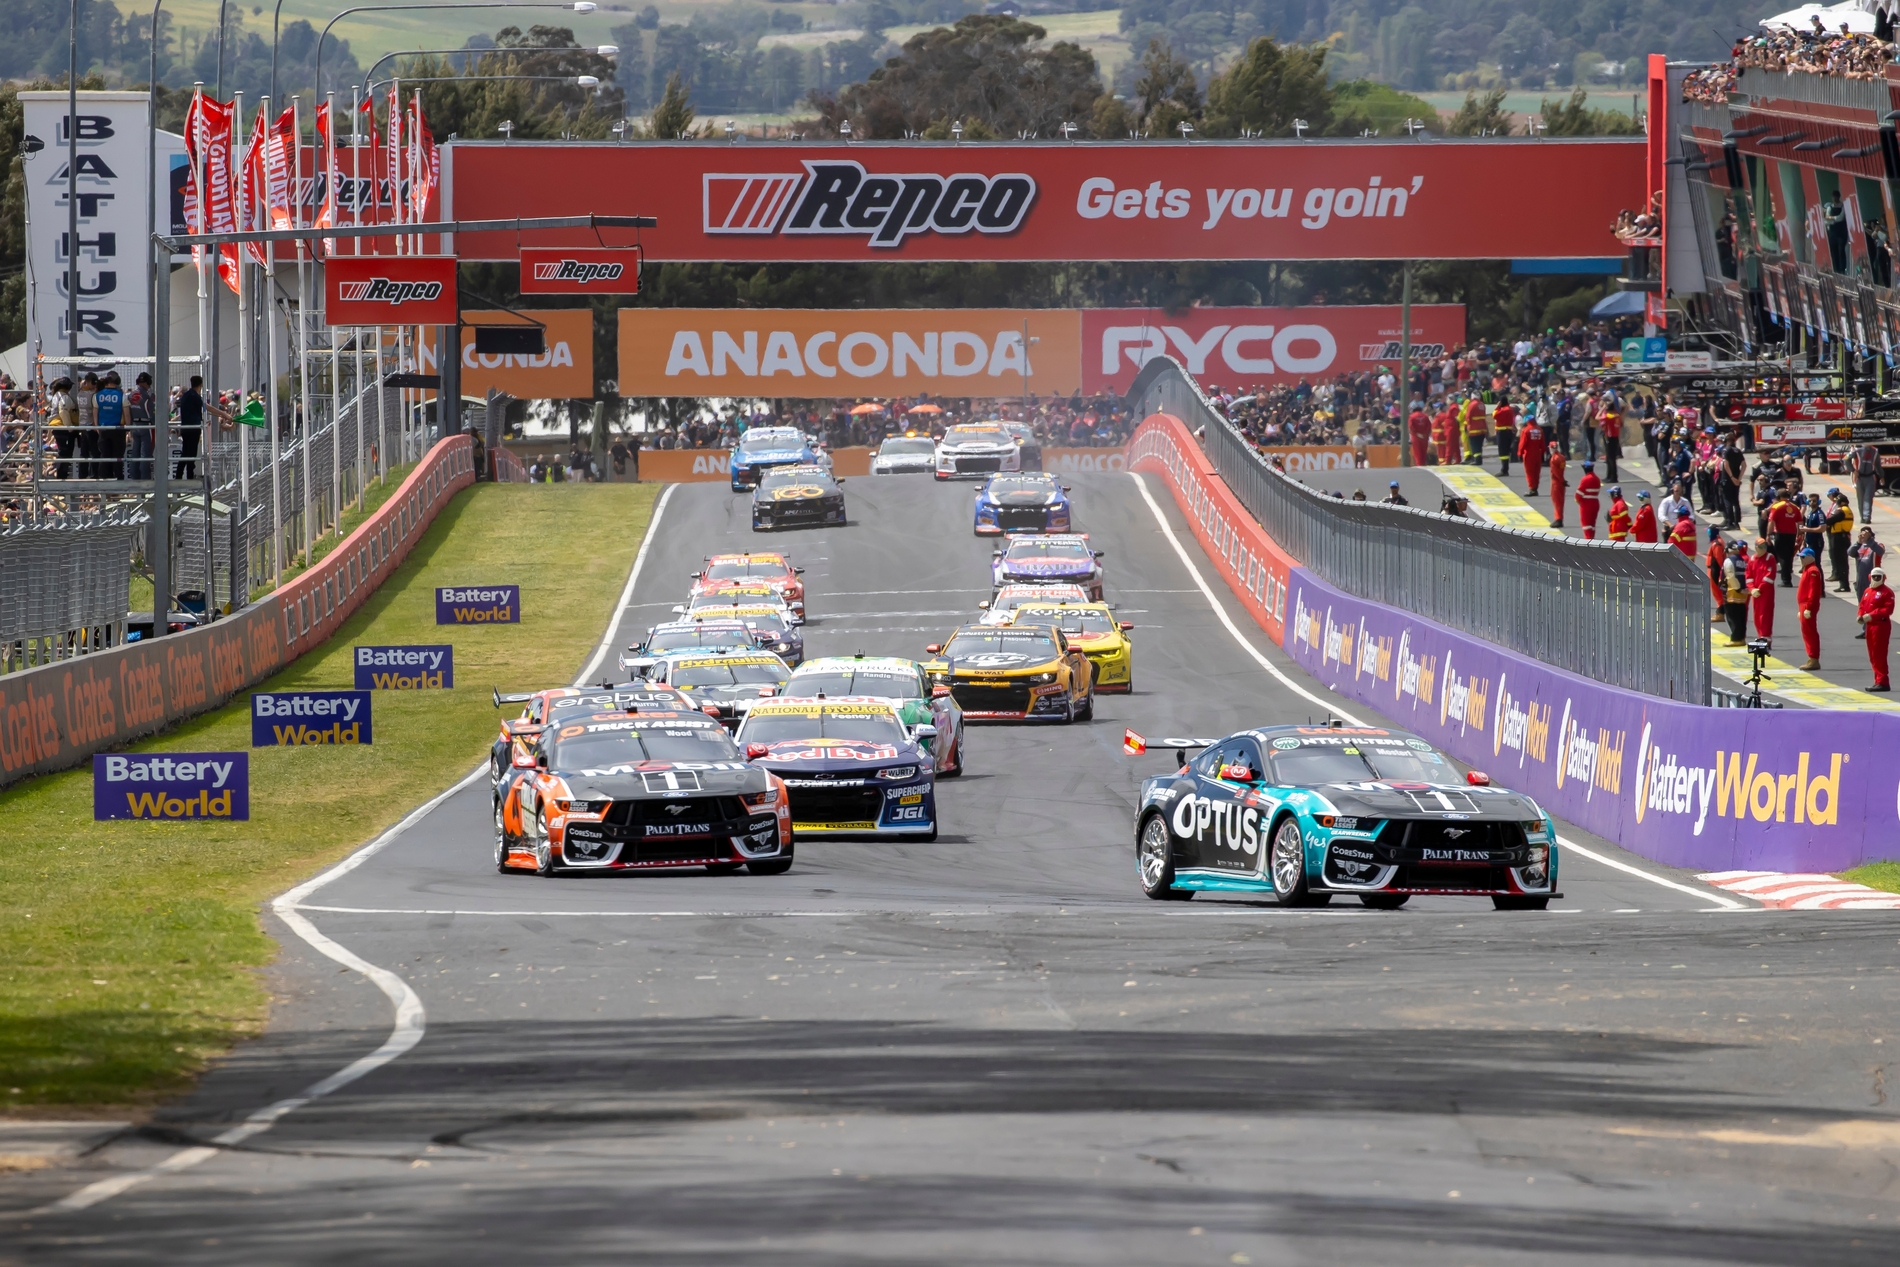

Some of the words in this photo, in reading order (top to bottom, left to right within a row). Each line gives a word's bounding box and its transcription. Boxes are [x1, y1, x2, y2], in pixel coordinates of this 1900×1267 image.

[783, 161, 1036, 246] Repco
[1077, 177, 1191, 219] Gets
[1203, 188, 1293, 229] you
[557, 260, 623, 283] Repco
[369, 278, 442, 304] Repco
[665, 331, 1032, 377] ANACONDA
[1102, 325, 1336, 374] RYCO
[99, 394, 119, 403] 040
[1745, 408, 1766, 417] Pizza
[1767, 408, 1783, 416] Hut
[442, 588, 511, 605] Battery
[454, 606, 511, 622] World
[1026, 608, 1101, 616] Kubota
[358, 648, 444, 670] Battery
[679, 656, 779, 668] Hydraulink
[372, 671, 443, 689] World
[120, 653, 164, 729] Coates
[555, 692, 675, 708] erebus
[64, 666, 116, 747] Coates
[256, 695, 361, 721] Battery
[753, 706, 818, 716] NATIONAL
[824, 706, 890, 715] STORAGE
[273, 722, 360, 746] World
[587, 721, 648, 732] TRUCK
[650, 720, 714, 729] ASSIST
[1296, 727, 1391, 737] Coates
[1301, 737, 1342, 746] NTK
[1343, 737, 1405, 746] FILTERS
[828, 746, 899, 760] Bull
[1376, 748, 1413, 756] Mostert
[1567, 720, 1599, 802] Battery
[1596, 727, 1626, 794] World
[105, 756, 233, 788] Battery
[659, 772, 680, 789] 1
[887, 782, 932, 800] SUPERCHEAP
[1649, 746, 1716, 836] Battery
[1716, 751, 1842, 825] World
[126, 790, 231, 817] World
[1426, 790, 1457, 811] 1
[1173, 793, 1258, 855] OPTUS
[1334, 816, 1358, 824] TRUCK
[645, 824, 675, 836] PALM
[676, 823, 710, 835] TRANS
[1422, 848, 1452, 860] PALM
[1455, 849, 1490, 860] TRANS
